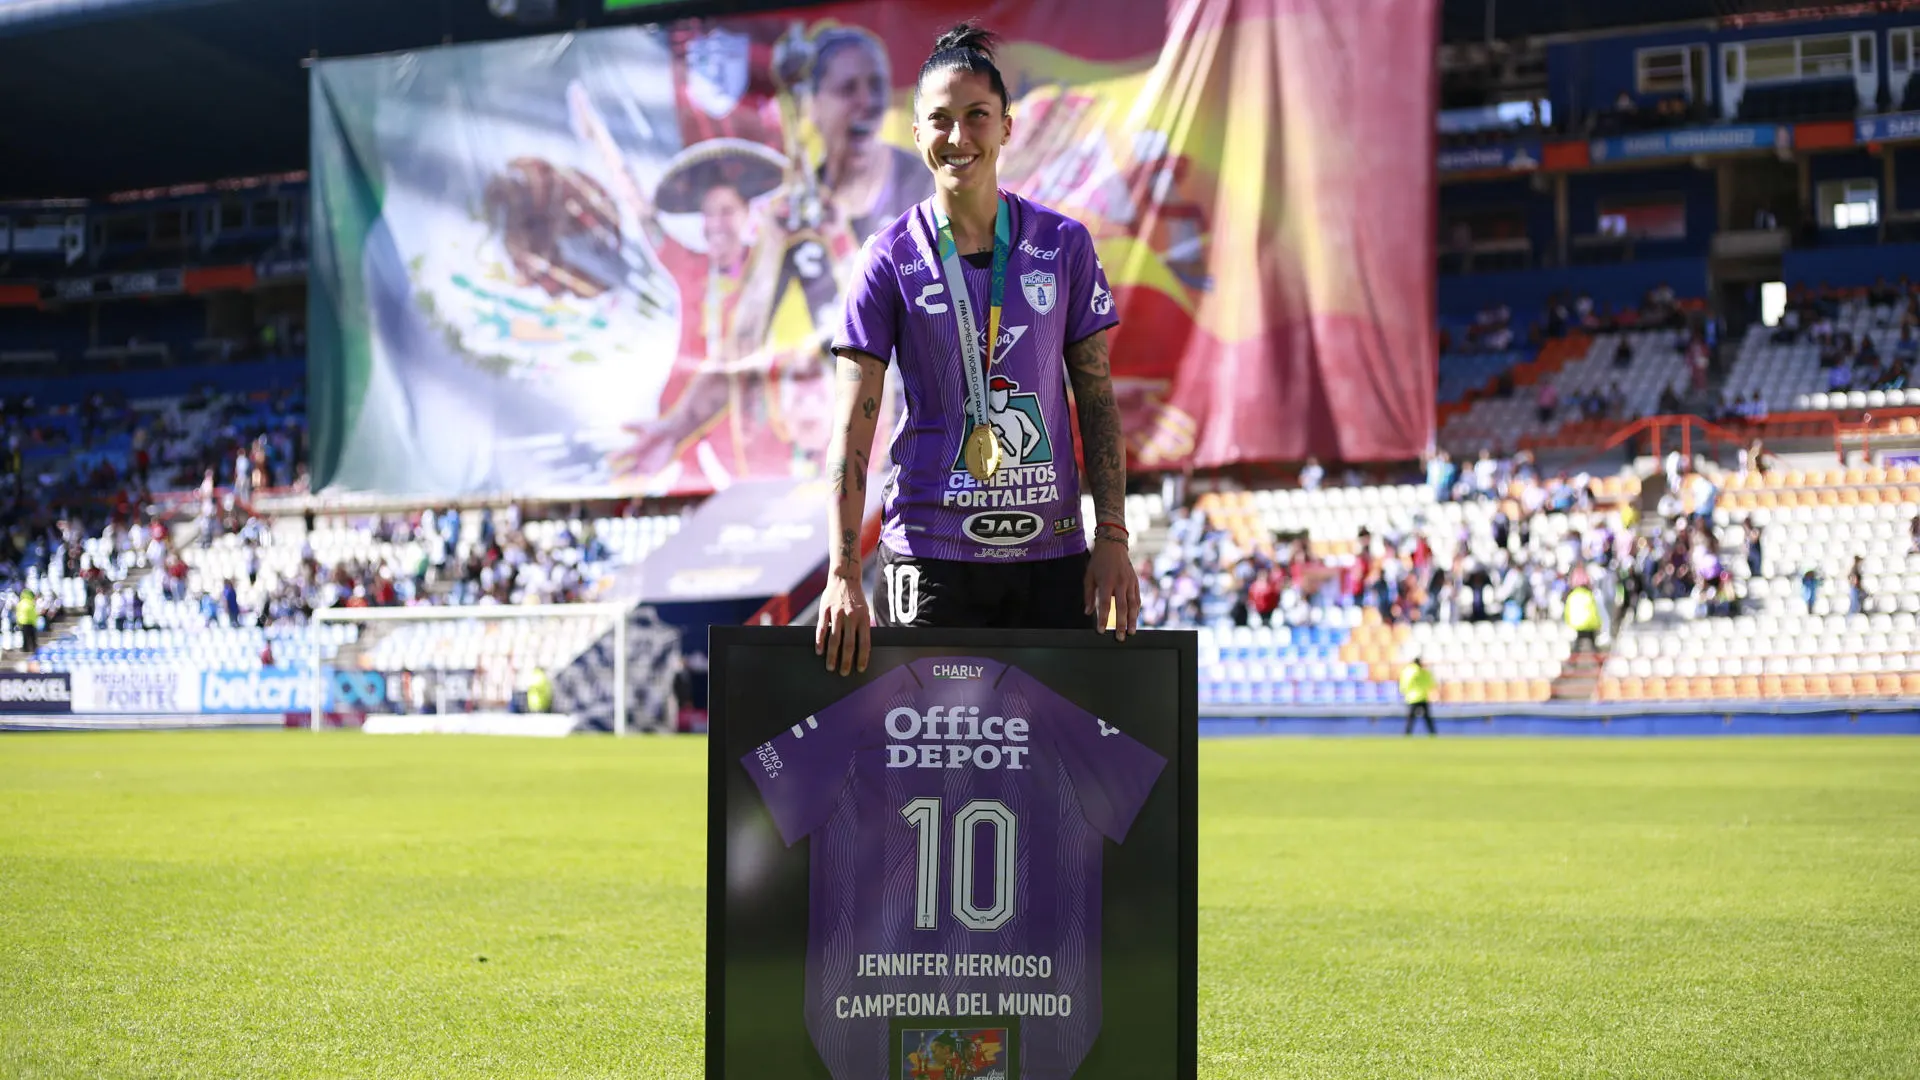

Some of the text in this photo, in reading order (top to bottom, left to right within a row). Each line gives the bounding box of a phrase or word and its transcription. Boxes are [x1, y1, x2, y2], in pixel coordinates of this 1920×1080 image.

[1018, 239, 1060, 260] telcel
[958, 299, 967, 316] FIFA
[961, 315, 974, 353] WOMEN'S
[967, 354, 978, 382] WORLD
[972, 383, 980, 400] CUP
[949, 465, 1057, 489] CEMENTOS
[943, 485, 1059, 507] FORTALEZA
[976, 519, 1032, 534] JAC
[883, 563, 921, 623] 10
[932, 664, 984, 678] CHARLY
[0, 678, 70, 702] BROXEL
[885, 705, 1029, 742] Office
[899, 796, 1018, 932] 10
[856, 953, 1052, 979] JENNIFER HERMOSO
[835, 992, 1072, 1019] CAMPEONA DEL MUNDO
